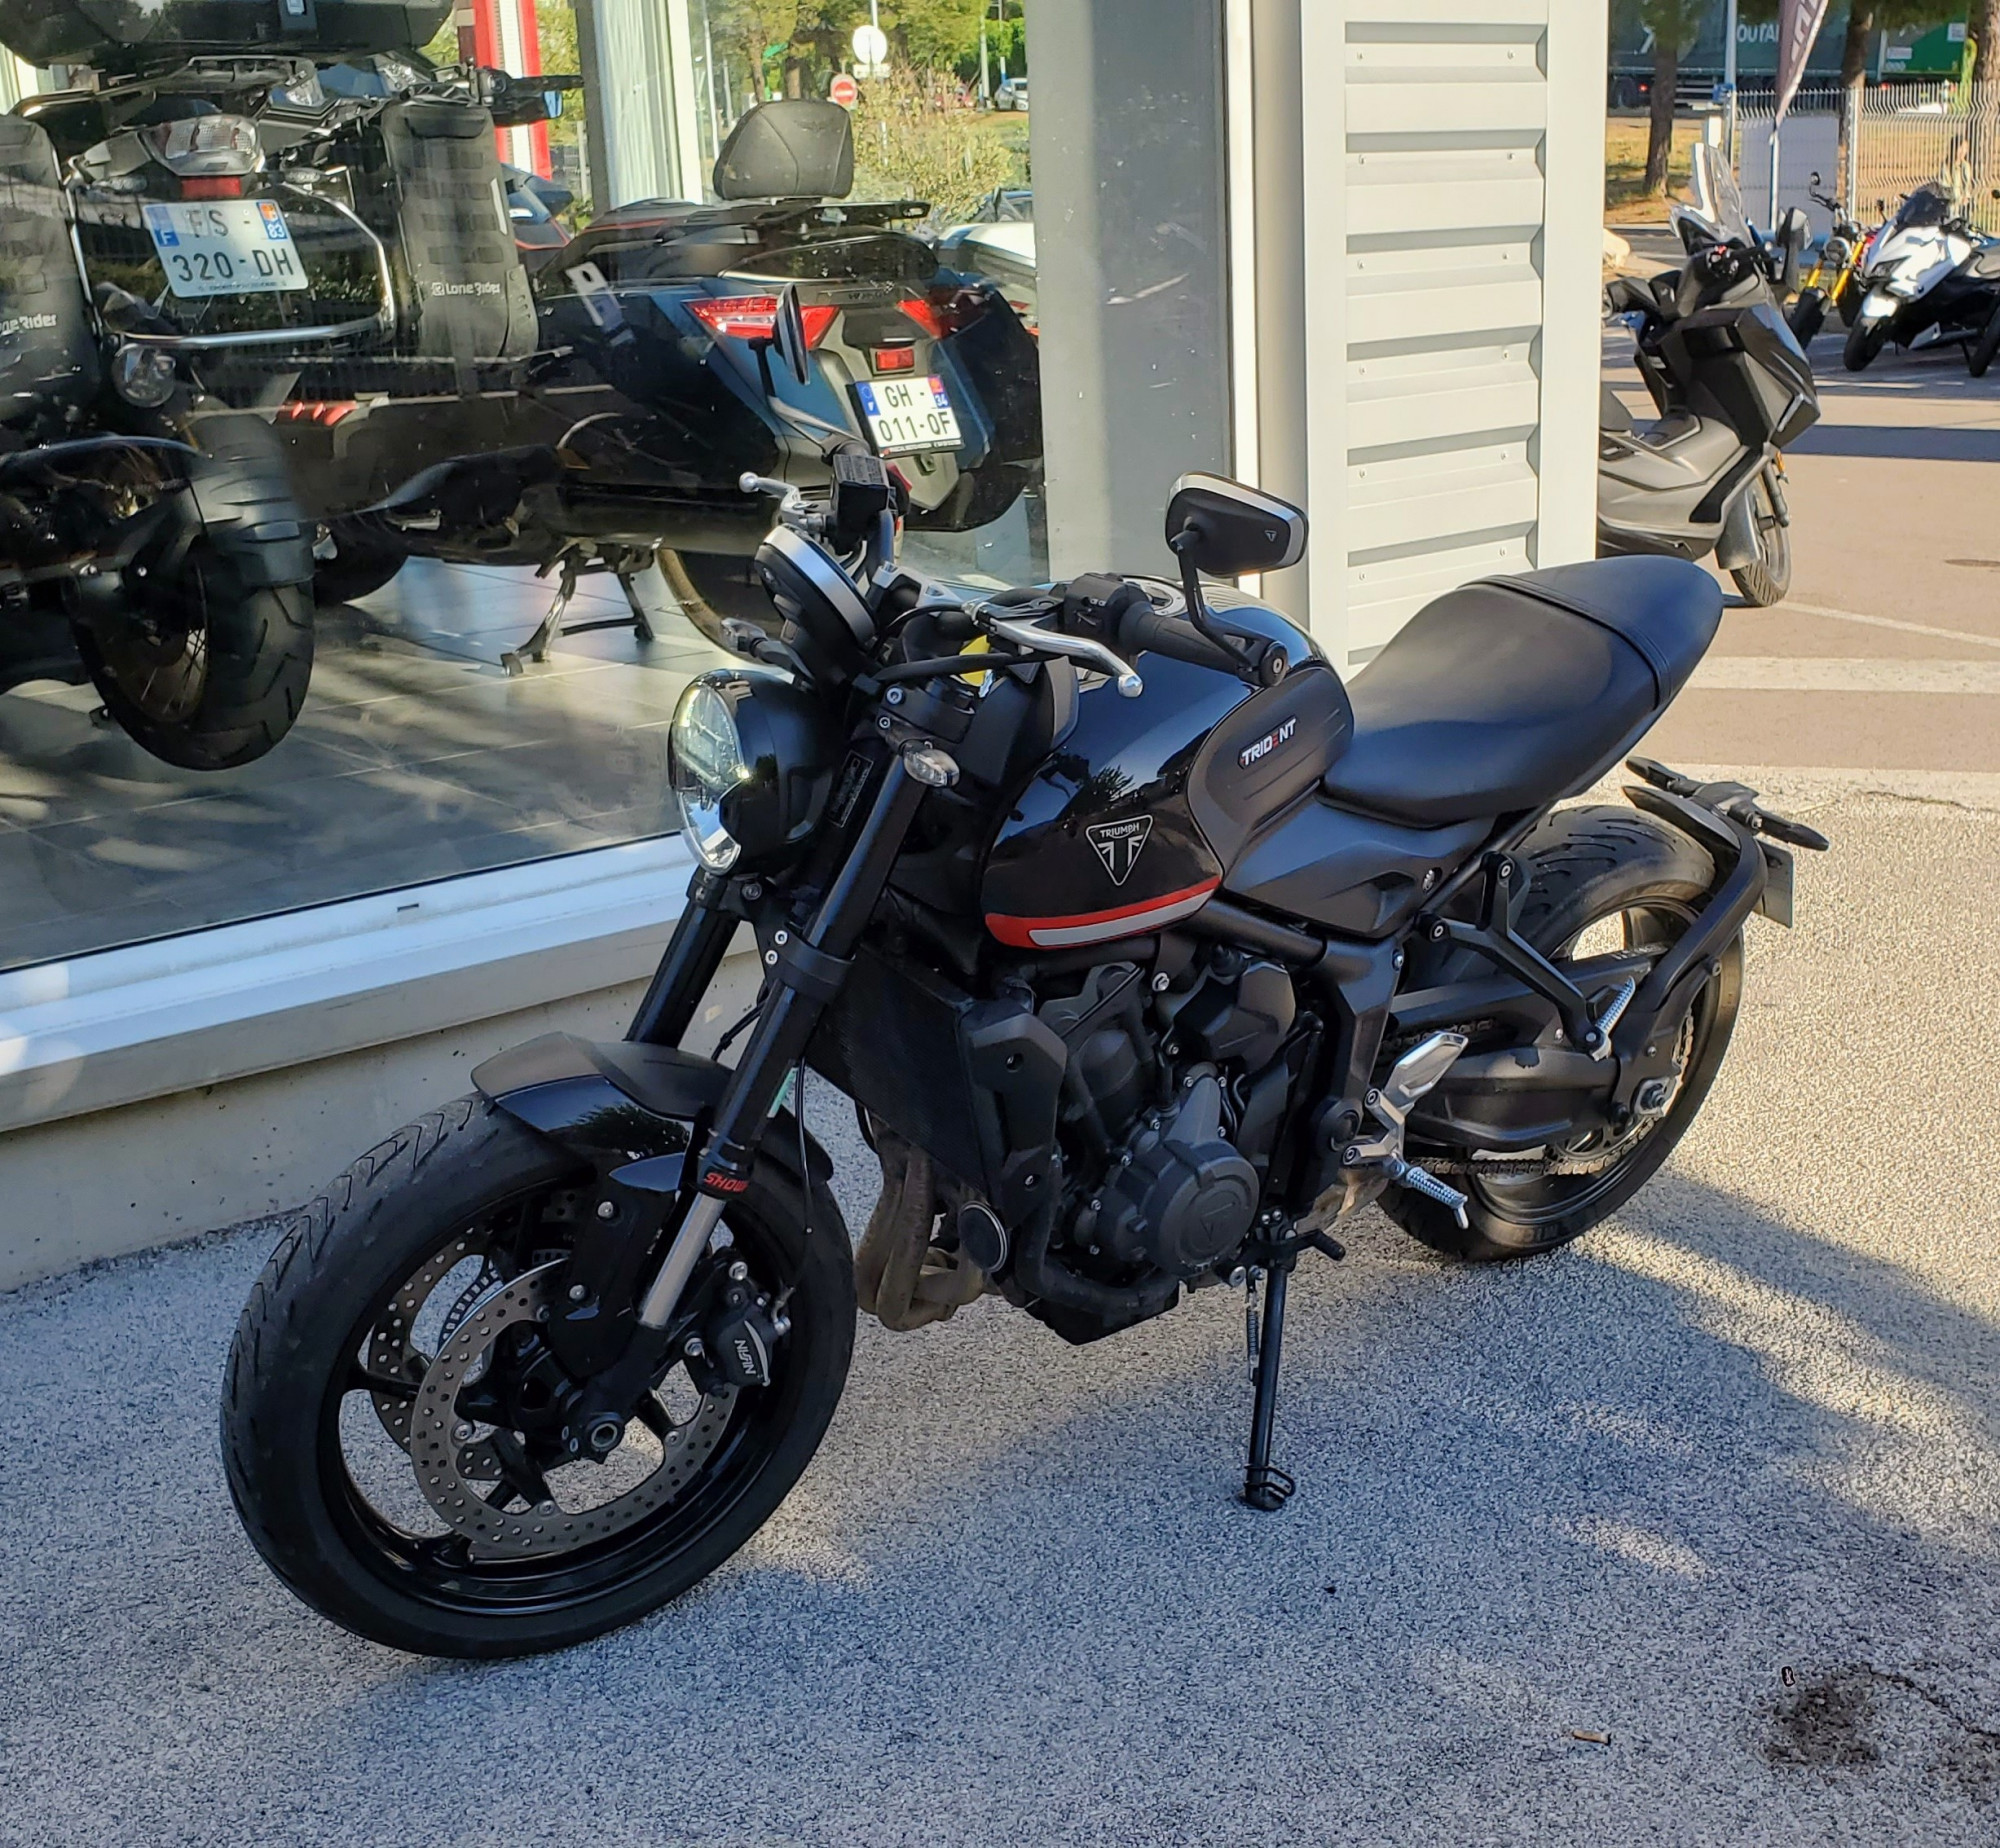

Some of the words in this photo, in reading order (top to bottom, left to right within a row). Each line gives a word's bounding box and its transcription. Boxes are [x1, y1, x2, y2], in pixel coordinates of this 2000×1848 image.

[267, 223, 285, 239] 83
[445, 283, 474, 295] Lone
[19, 313, 57, 330] Rider
[884, 383, 914, 409] GH
[933, 393, 949, 407] 34
[1241, 717, 1297, 767] TRIDENT
[1100, 821, 1140, 840] TRIUMPH
